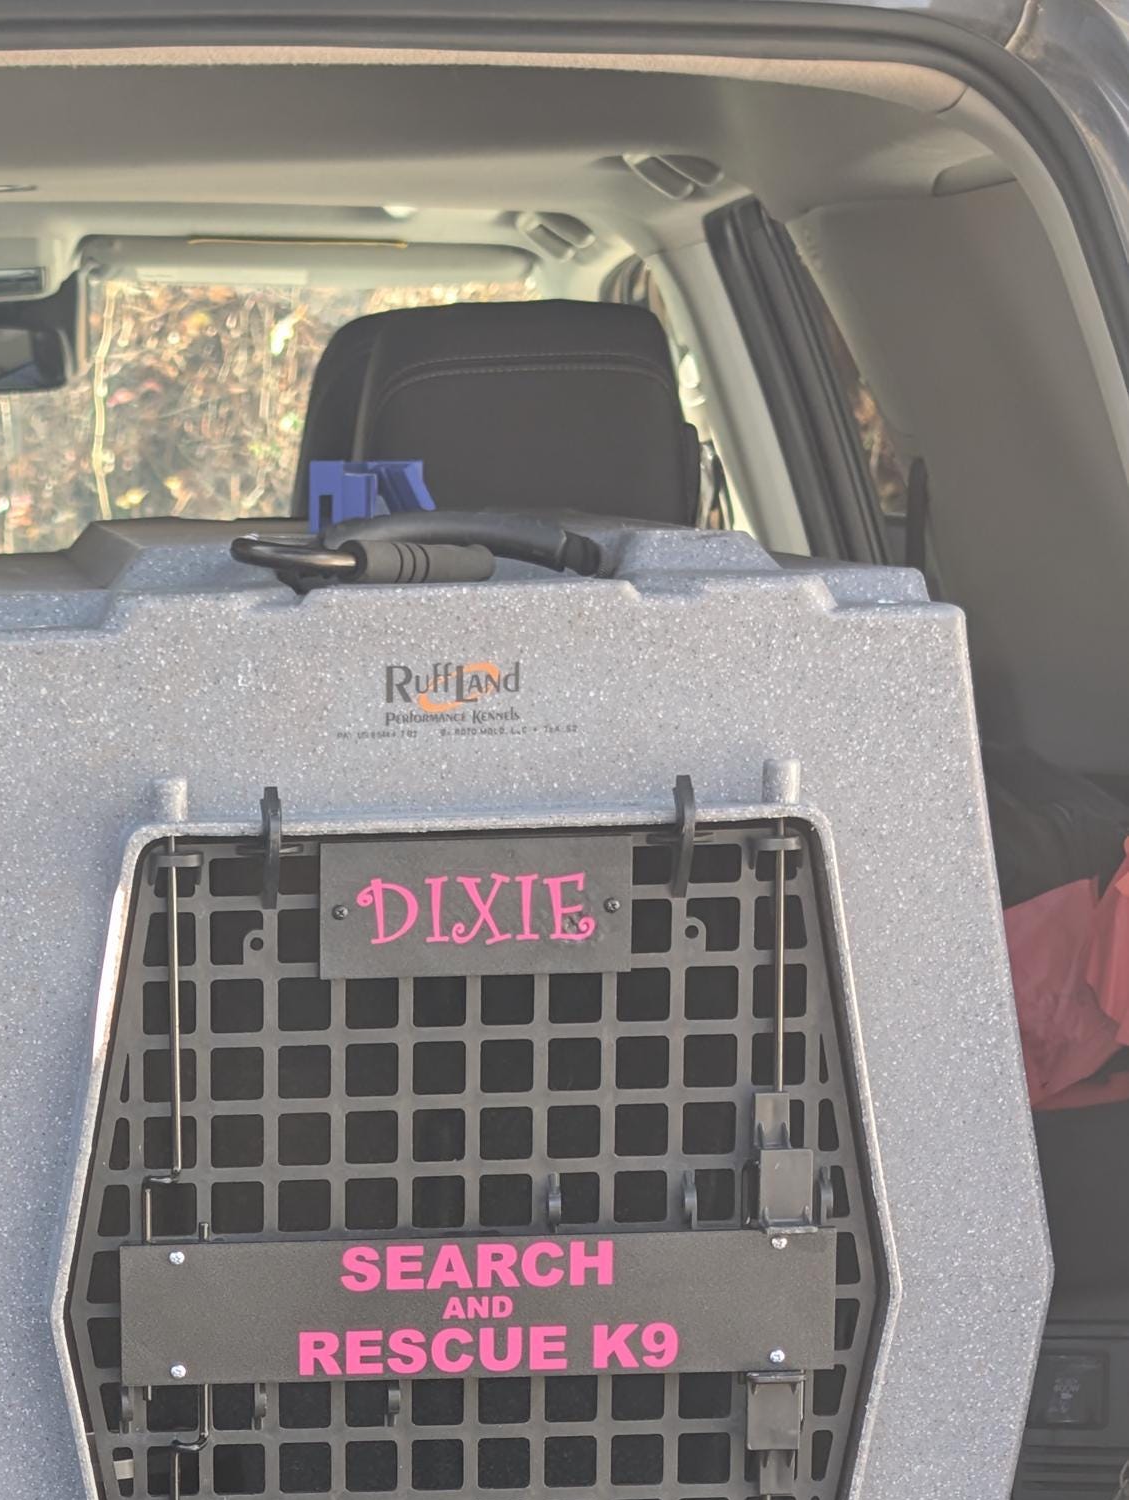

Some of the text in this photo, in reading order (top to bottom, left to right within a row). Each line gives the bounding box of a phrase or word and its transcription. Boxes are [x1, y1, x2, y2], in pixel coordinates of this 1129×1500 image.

[356, 872, 596, 945] DIXIE
[340, 1239, 614, 1292] SEARCH
[442, 1295, 513, 1320] AND
[298, 1321, 679, 1376] RESCUE K9
